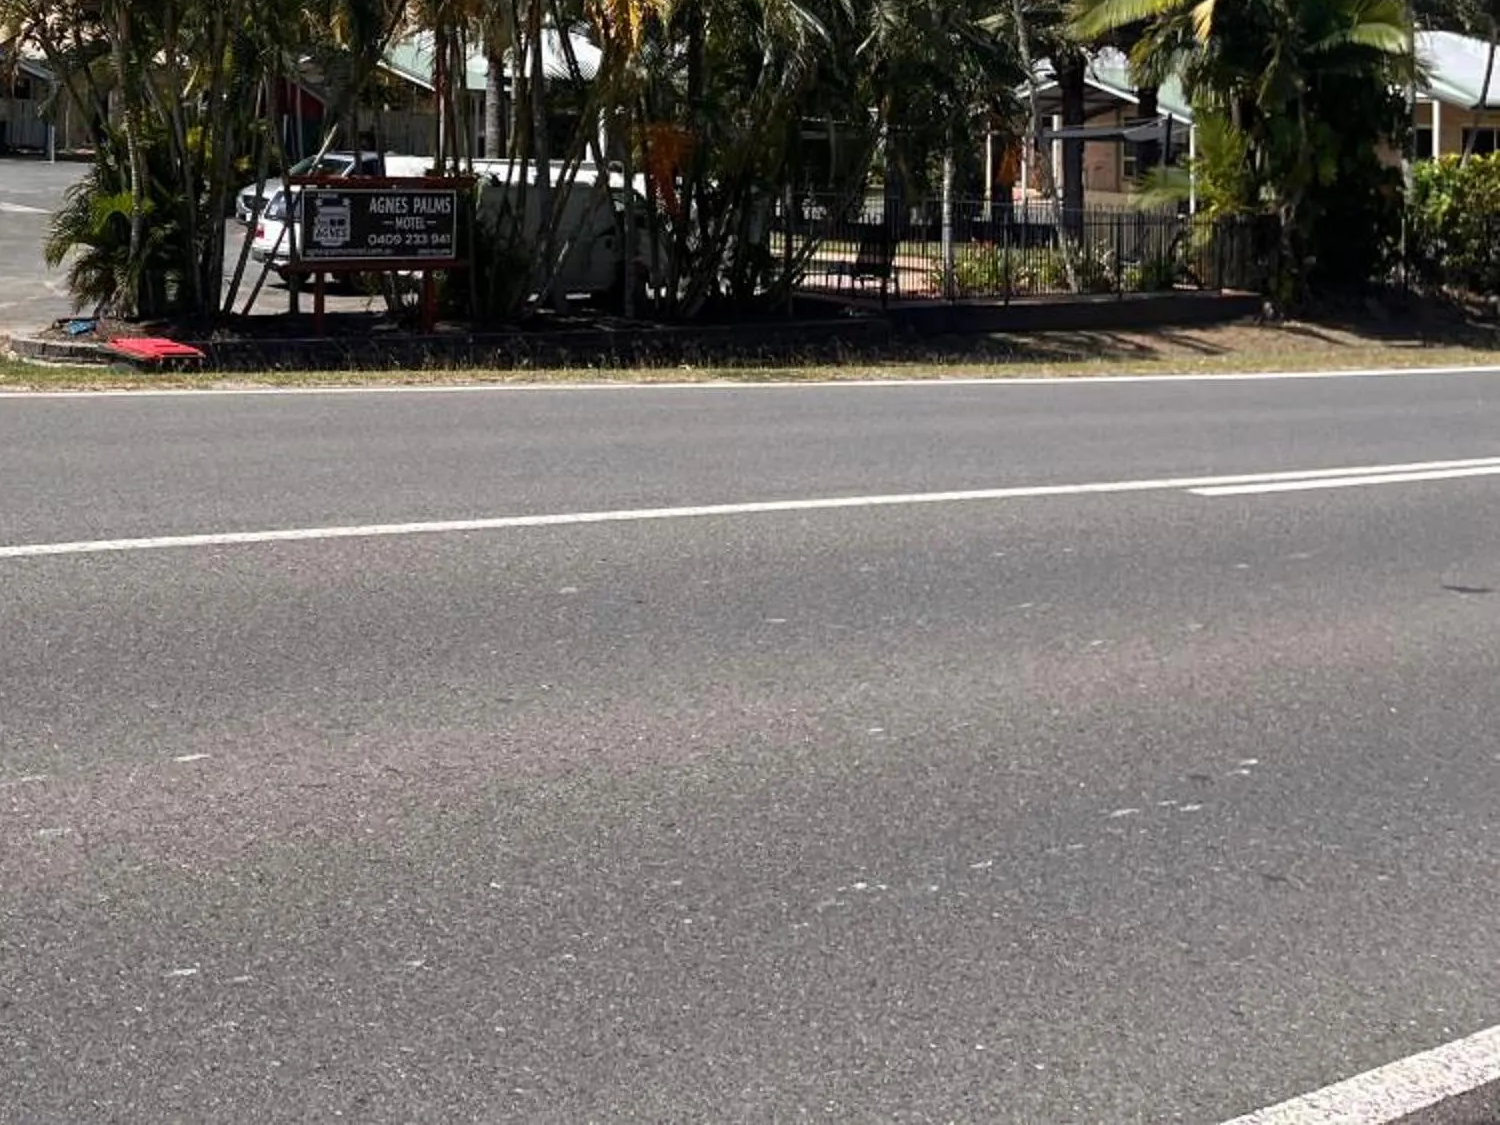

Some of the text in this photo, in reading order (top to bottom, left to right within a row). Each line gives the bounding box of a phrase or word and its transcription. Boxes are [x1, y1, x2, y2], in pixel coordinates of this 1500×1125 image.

[369, 196, 451, 214] AGNES PALMS
[395, 216, 426, 230] MOTEL
[367, 233, 402, 245] 0409
